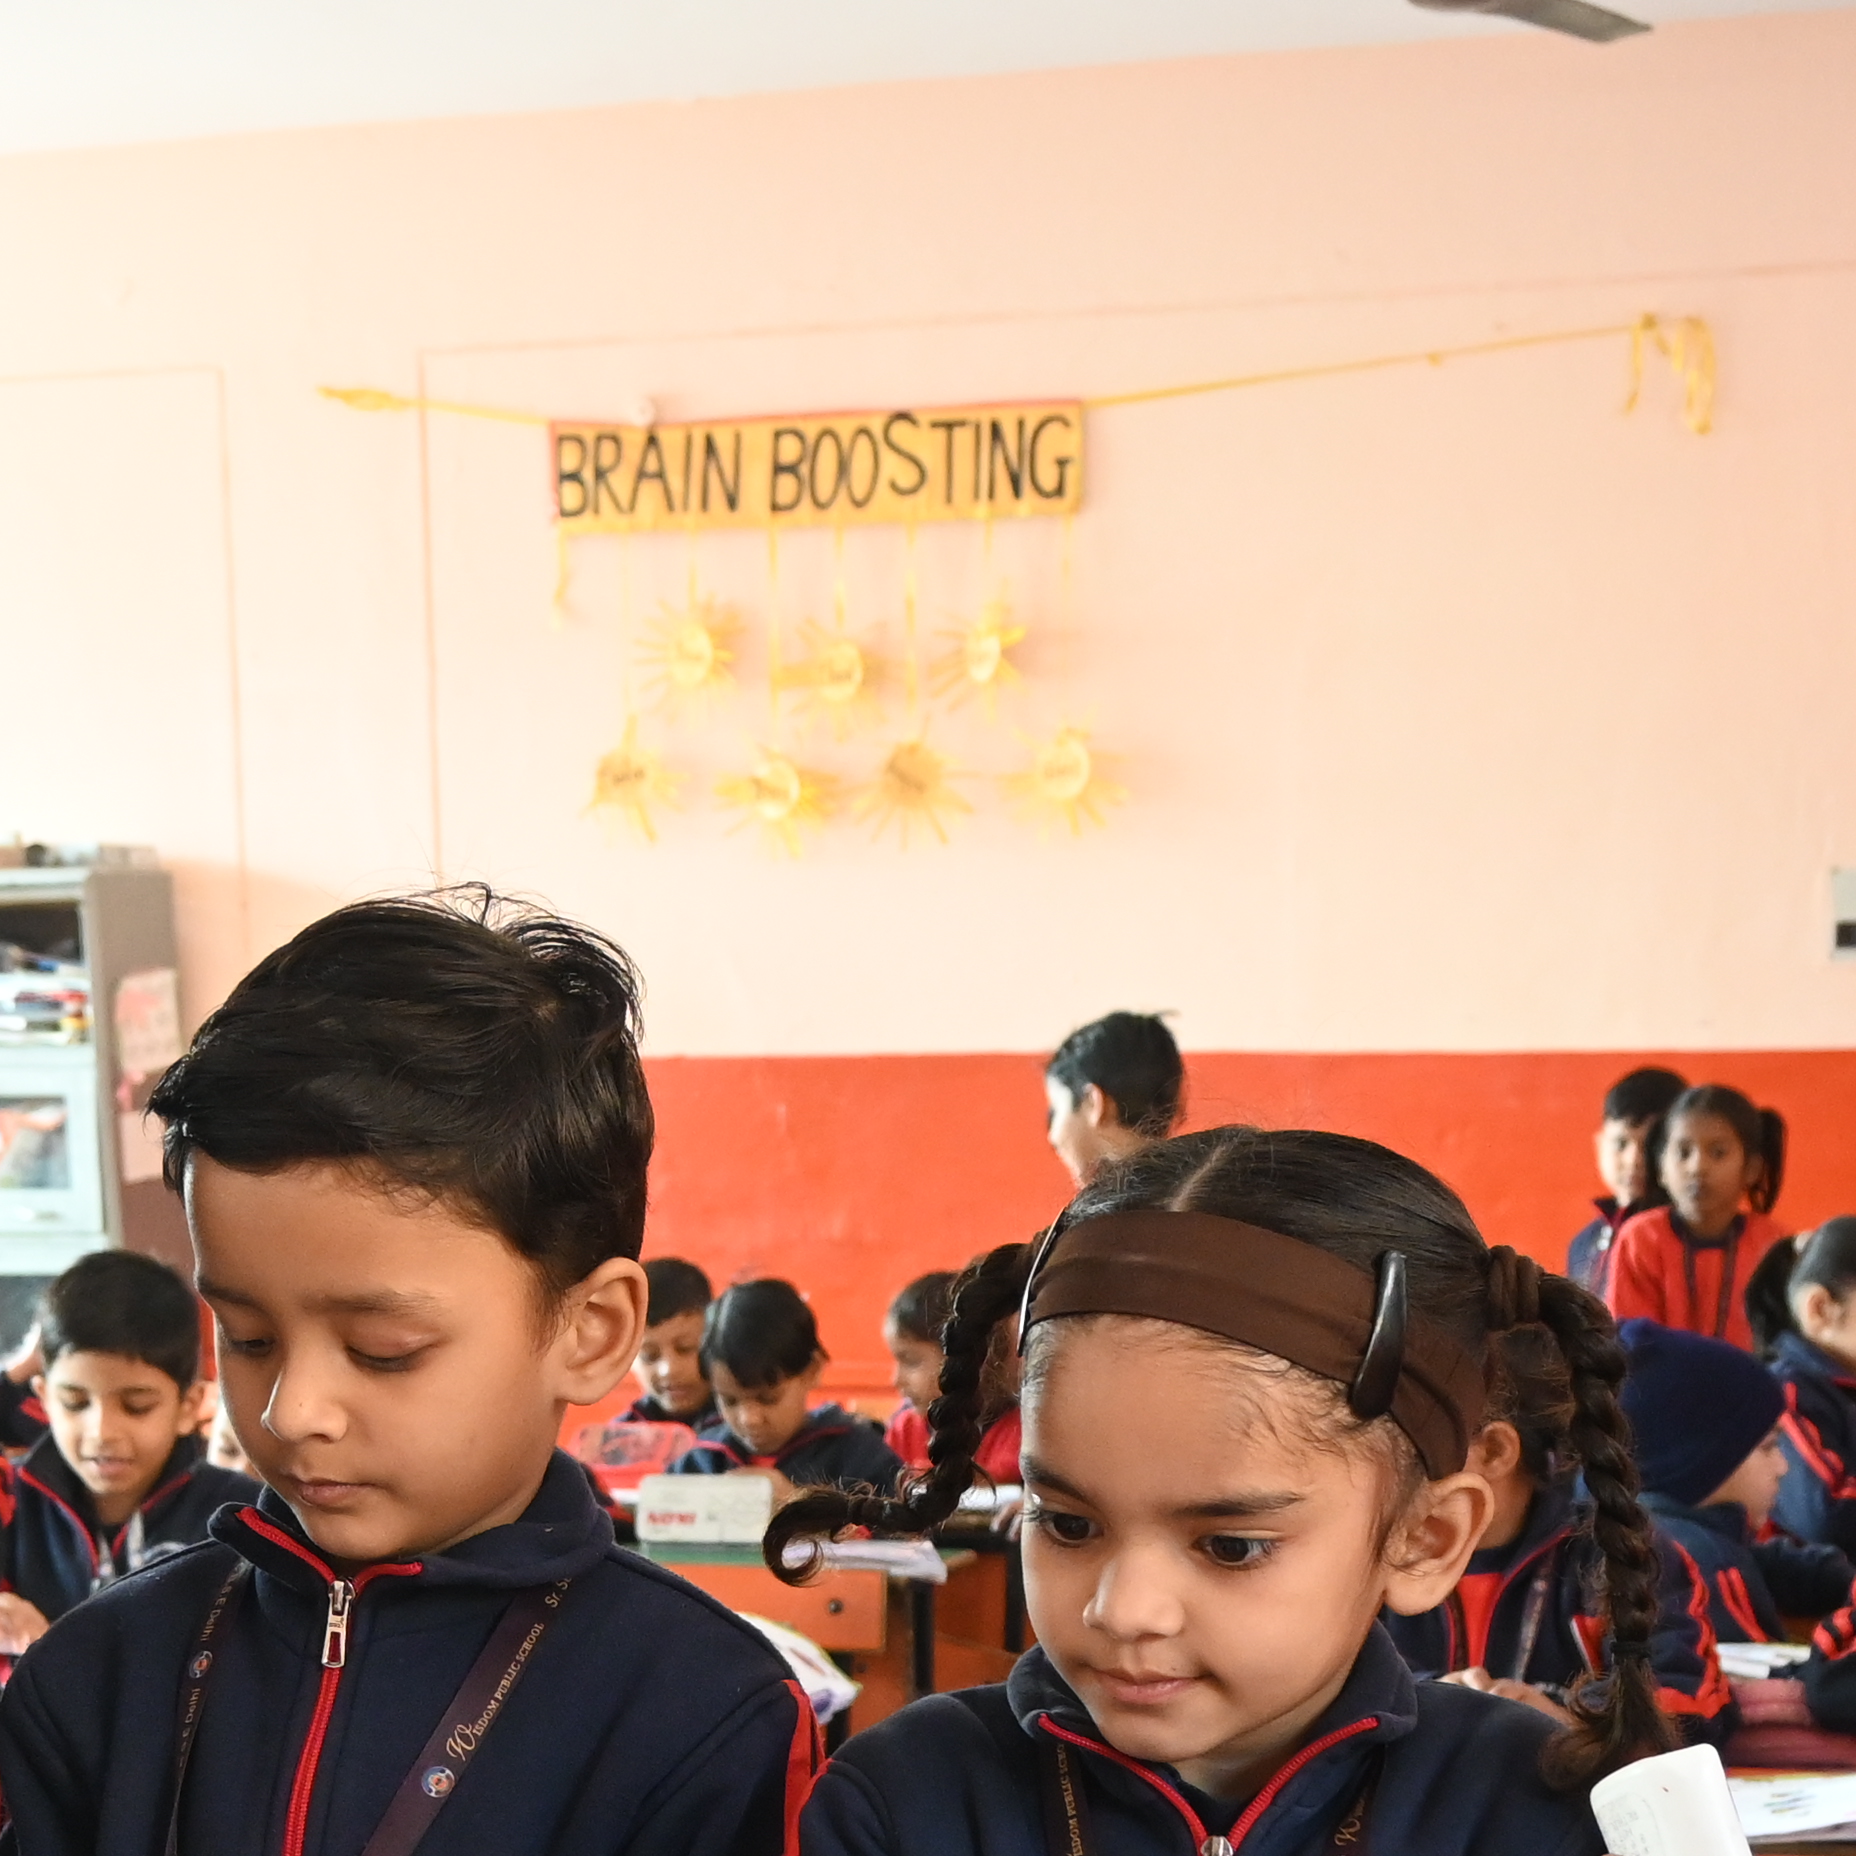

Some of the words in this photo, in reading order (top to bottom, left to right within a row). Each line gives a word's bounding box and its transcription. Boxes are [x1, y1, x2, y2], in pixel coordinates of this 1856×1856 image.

[557, 428, 742, 518] BRAIN
[769, 410, 1074, 512] BOOSTING
[184, 1688, 201, 1724] Delhi
[446, 1699, 500, 1761] WISDOM
[494, 1661, 521, 1700] PUBLIC
[515, 1622, 545, 1662] SCHOOL
